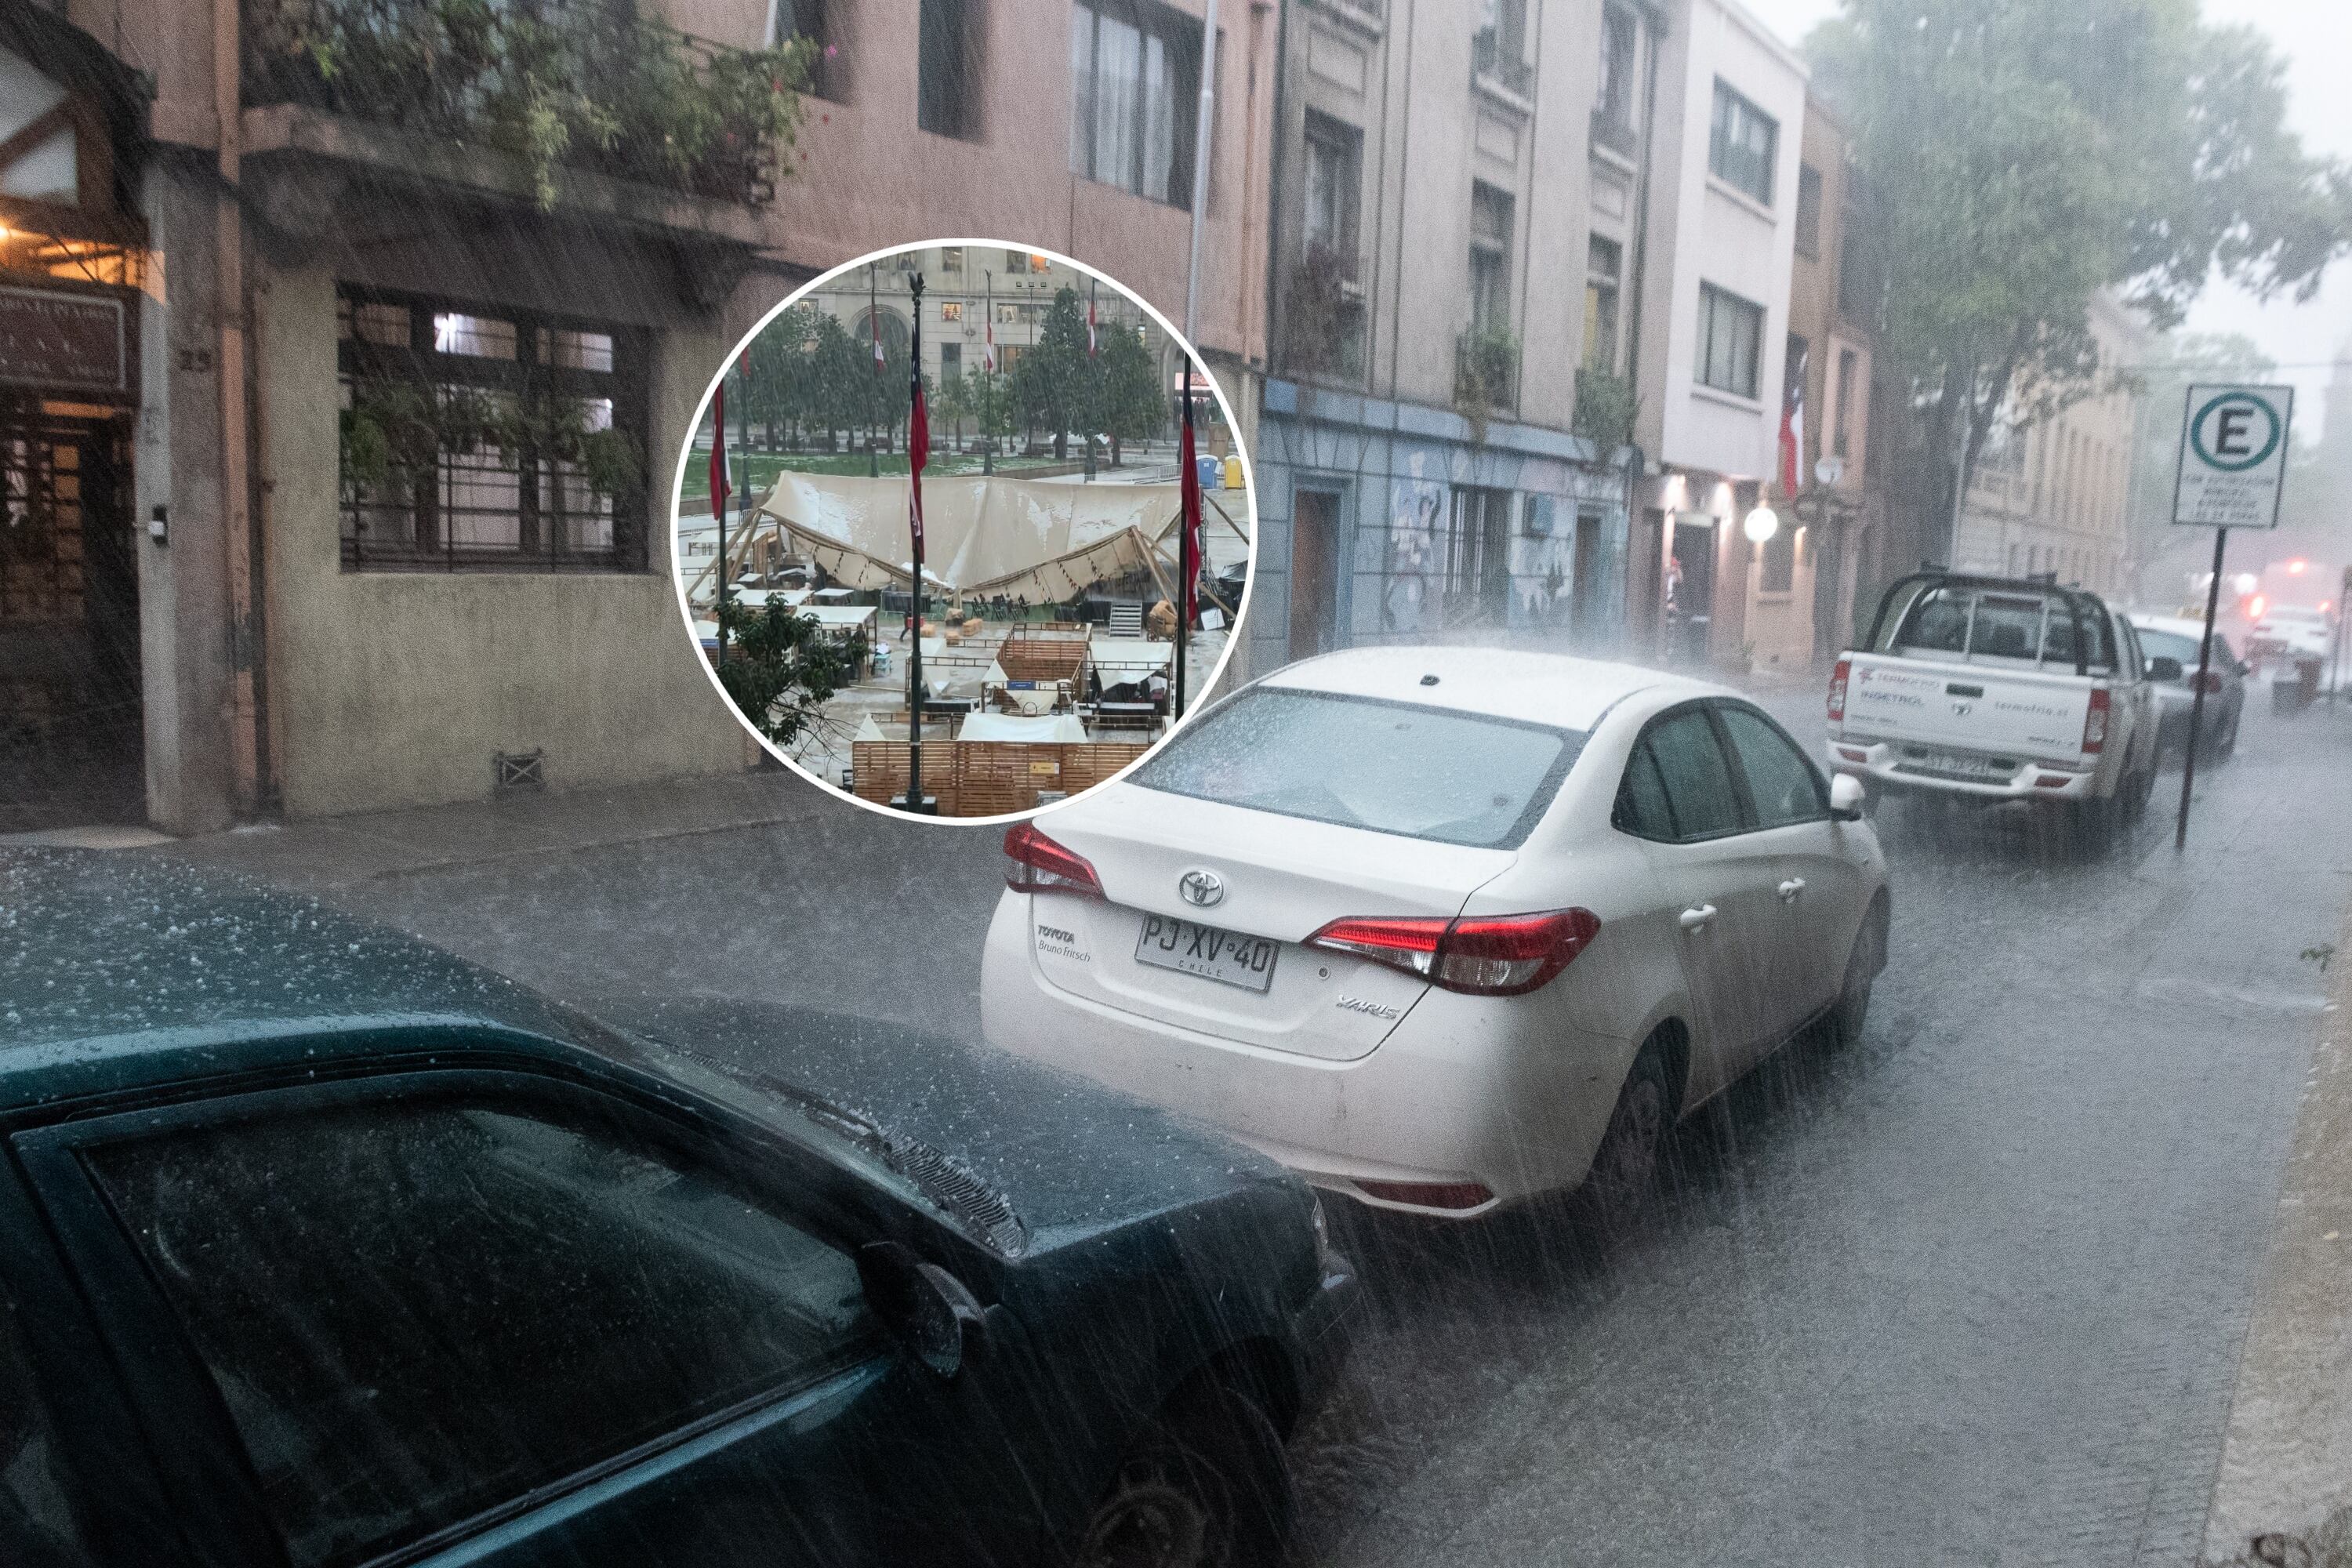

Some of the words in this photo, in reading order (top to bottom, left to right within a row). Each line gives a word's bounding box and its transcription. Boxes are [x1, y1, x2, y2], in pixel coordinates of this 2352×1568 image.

[2216, 408, 2256, 454] E
[1038, 925, 1074, 944] TOYOTA
[1039, 940, 1062, 954] Bruno
[1063, 946, 1091, 962] Fritsch
[1179, 960, 1222, 978] CHILE
[1336, 994, 1401, 1020] YARIS
